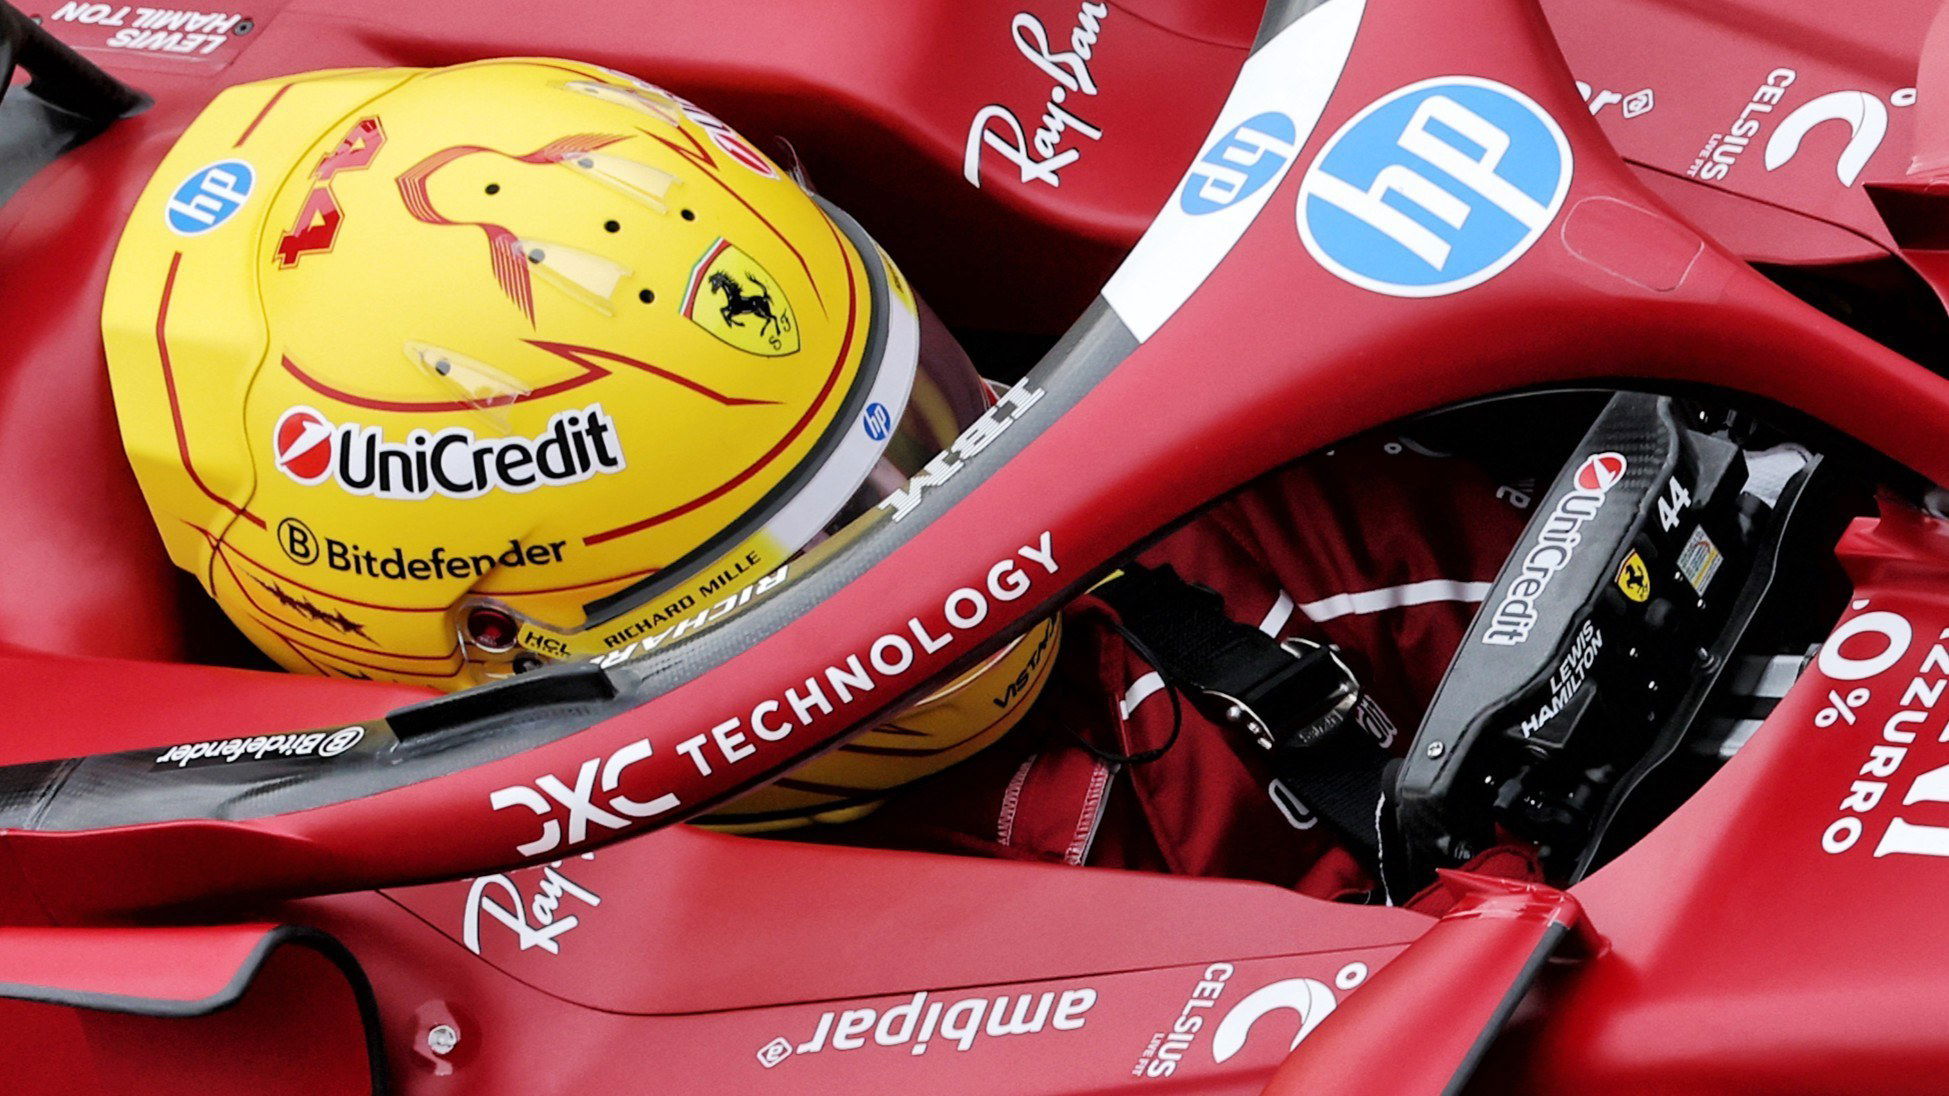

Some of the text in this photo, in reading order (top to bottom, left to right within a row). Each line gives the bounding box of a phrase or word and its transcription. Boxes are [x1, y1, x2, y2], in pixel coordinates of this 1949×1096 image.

[52, 0, 243, 35] HAMILTON
[107, 26, 228, 56] LEWIS
[1182, 112, 1296, 215] hp
[1699, 67, 1797, 181] CELSIUS
[170, 165, 252, 228] hp
[1302, 93, 1548, 273] hp
[338, 409, 619, 494] UniCredit
[864, 403, 891, 441] hp
[877, 375, 1047, 523] IBM
[1657, 474, 1692, 533] 44
[324, 538, 567, 581] Bitdefender
[603, 550, 762, 649] RICHARD MILLE
[1484, 492, 1605, 645] UniCredit
[524, 631, 571, 656] HCL
[1520, 628, 1604, 738] HAMILTON
[1550, 619, 1595, 694] LEWIS
[489, 530, 1060, 858] DXC TECHNOLOGY
[156, 731, 327, 768] Bitdefender
[1821, 627, 1949, 855] ZZURRO
[796, 987, 1098, 1056] ambipar
[1147, 962, 1235, 1078] CELSIUS
